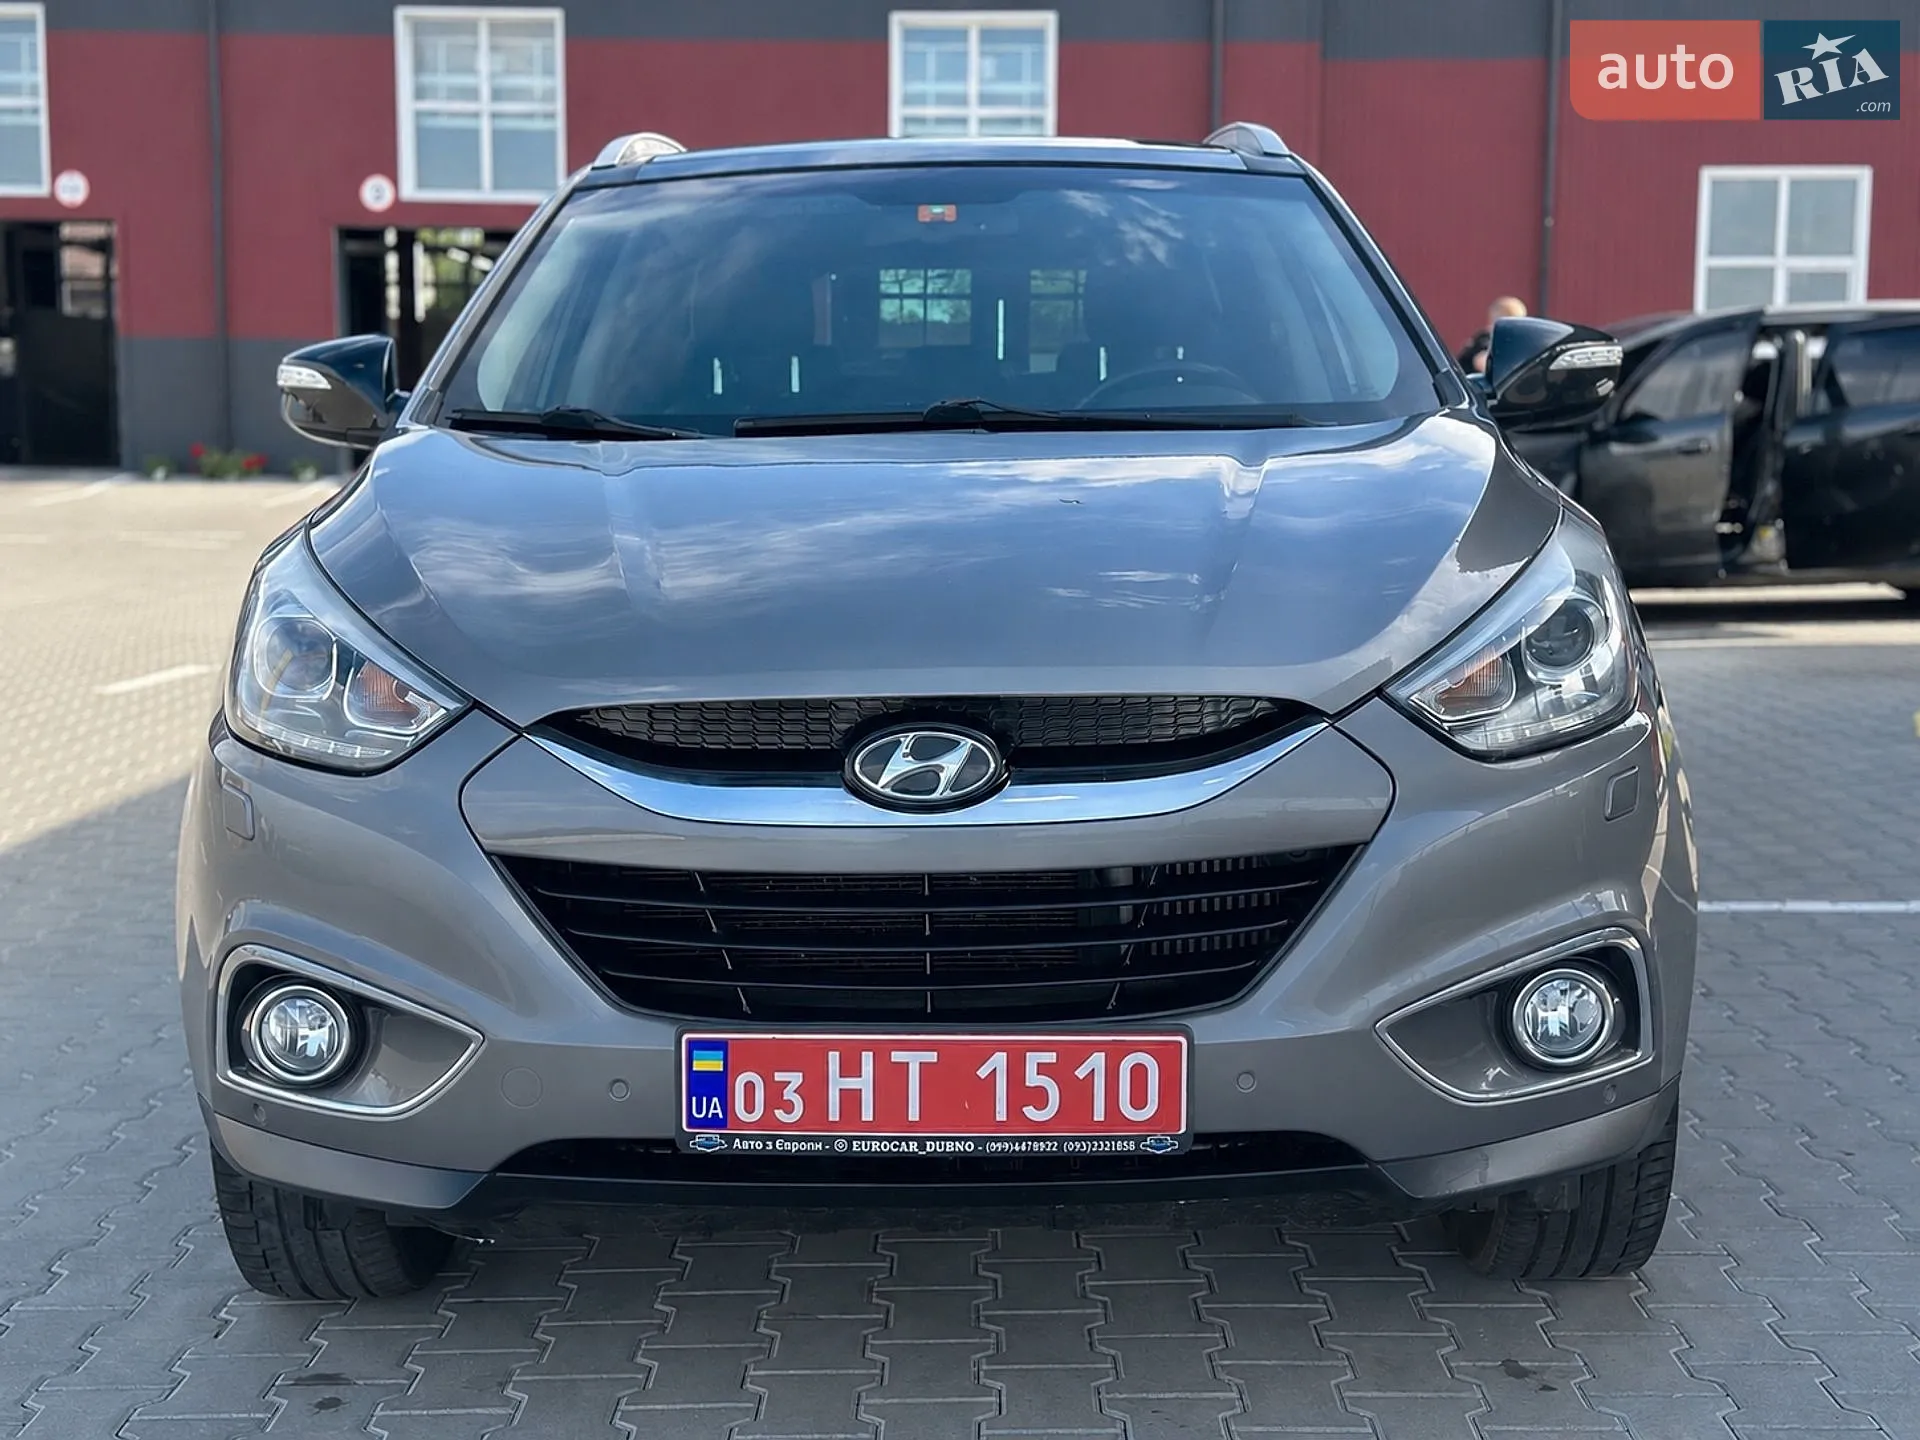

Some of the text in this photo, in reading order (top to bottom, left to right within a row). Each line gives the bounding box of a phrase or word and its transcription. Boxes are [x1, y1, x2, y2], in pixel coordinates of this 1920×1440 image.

[734, 1050, 1161, 1123] 03 HT 1510
[691, 1096, 724, 1119] UA
[852, 1140, 975, 1154] EUROCAR_DUBNO
